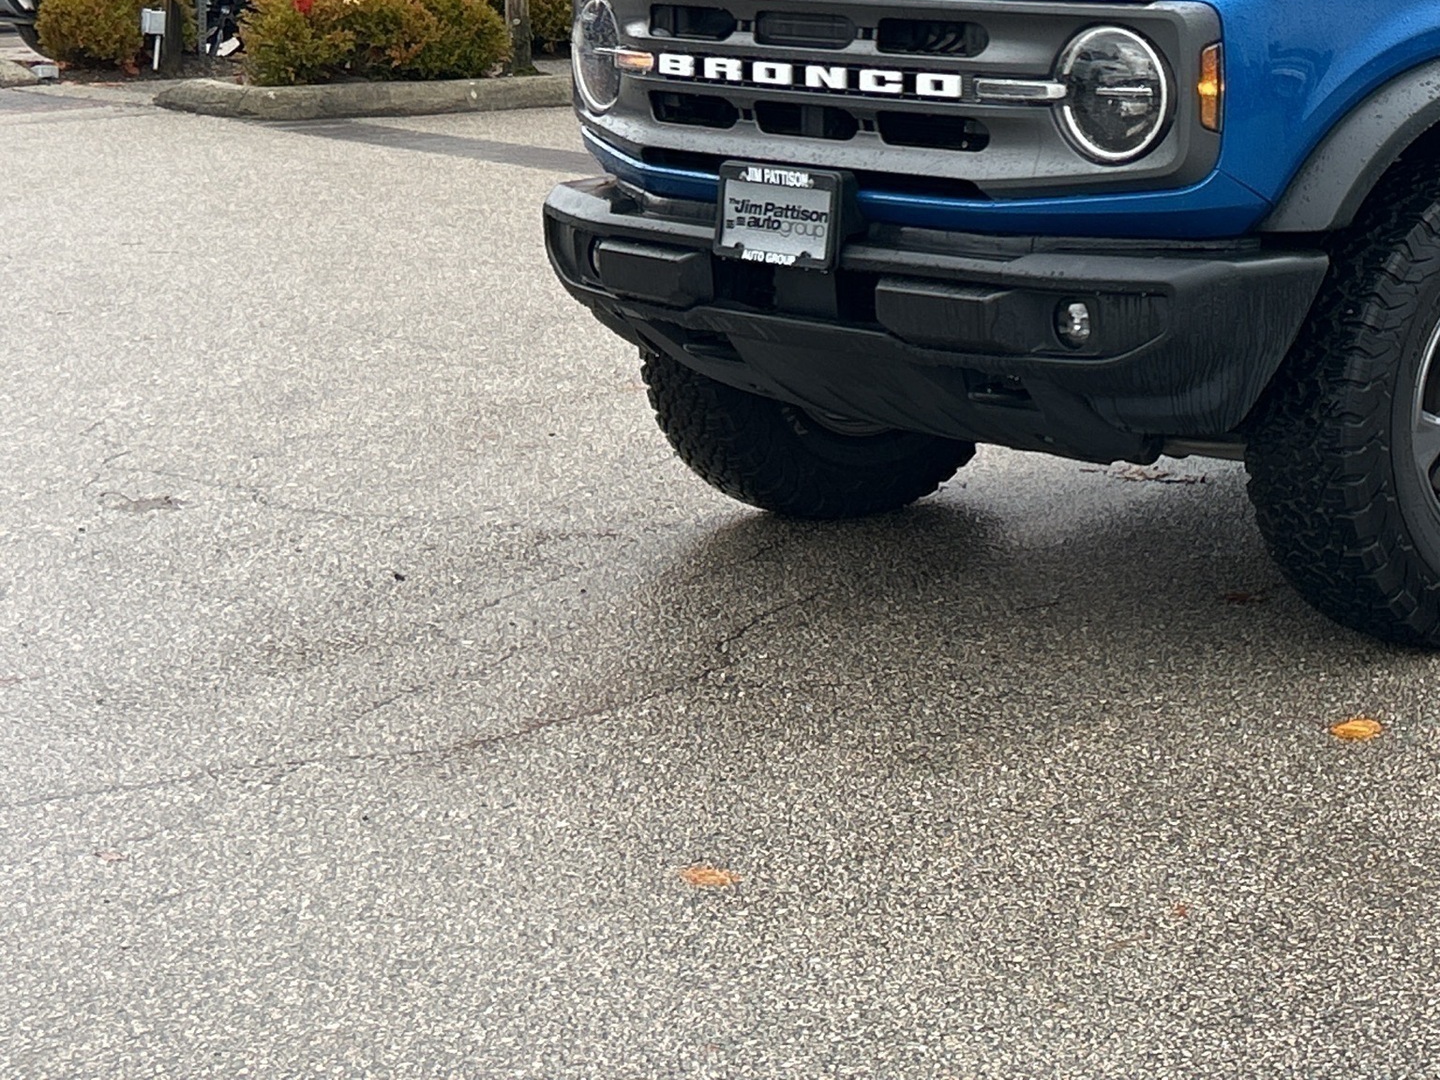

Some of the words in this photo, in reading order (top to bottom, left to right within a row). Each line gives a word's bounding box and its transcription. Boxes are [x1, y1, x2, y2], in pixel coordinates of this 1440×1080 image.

[658, 52, 962, 98] BRONCO
[745, 166, 762, 182] JIM
[763, 168, 809, 188] PATTISON
[741, 248, 764, 262] AUTO
[765, 252, 796, 266] GROUP
